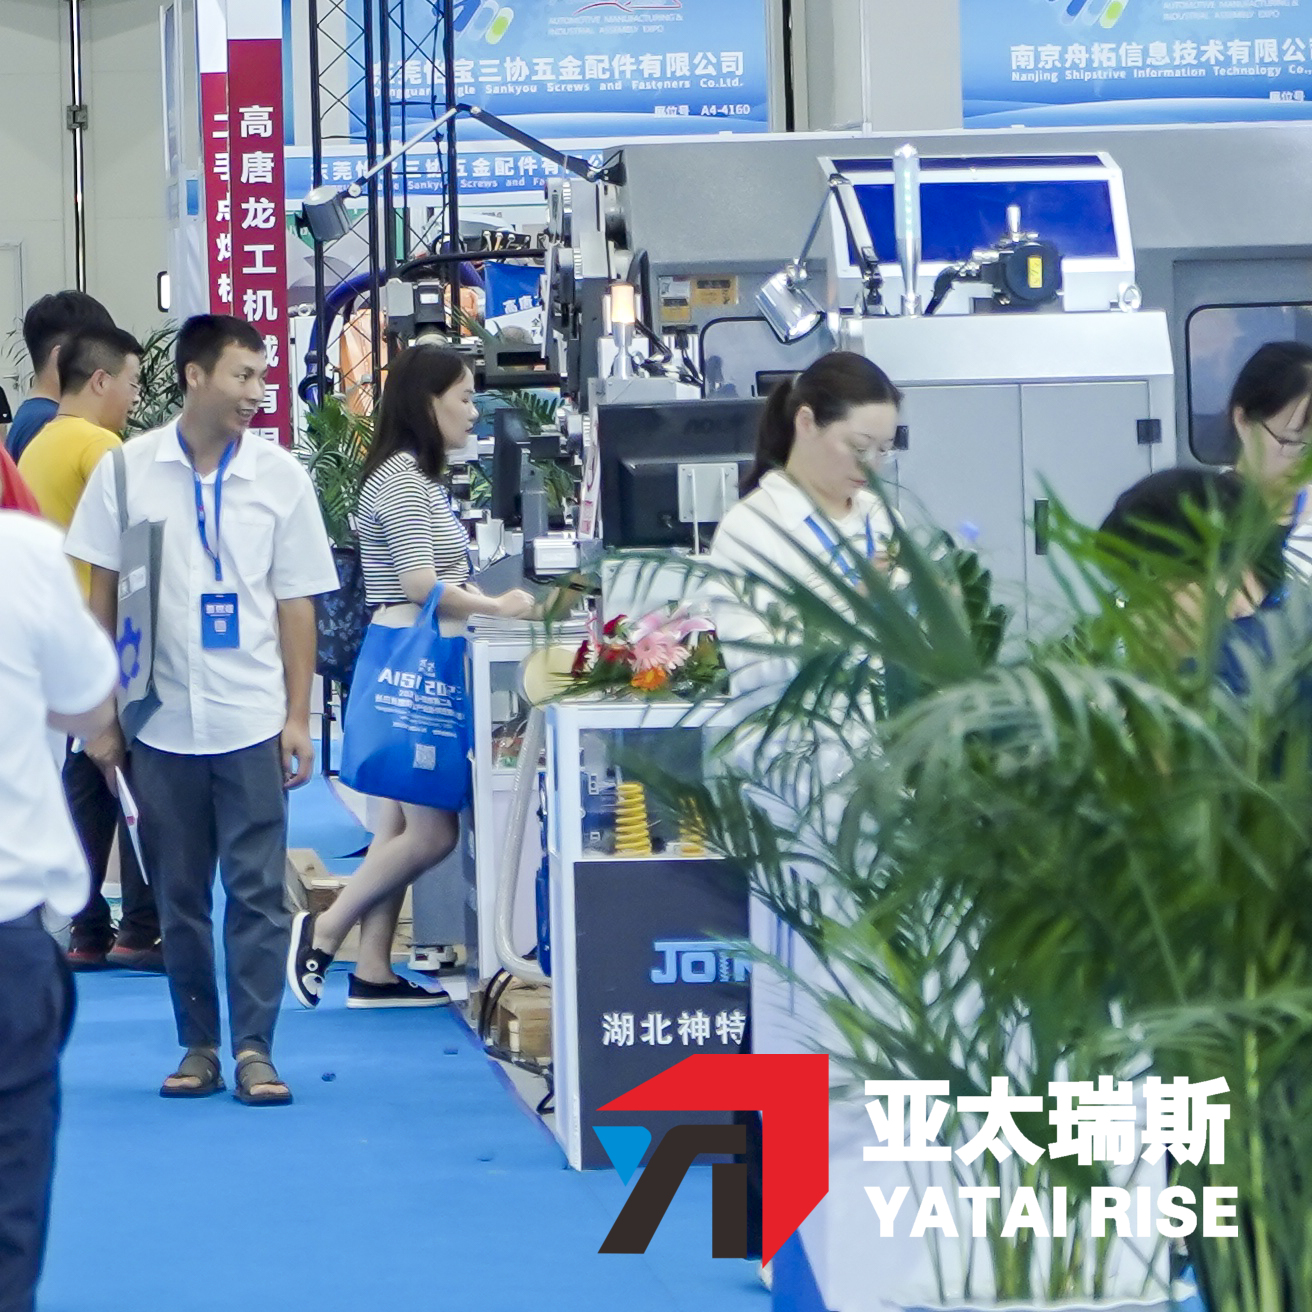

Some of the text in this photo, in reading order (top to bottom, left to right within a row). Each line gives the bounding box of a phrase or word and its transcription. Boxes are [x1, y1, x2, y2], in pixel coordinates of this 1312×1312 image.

[1010, 37, 1312, 69] 南京舟拓信息技术有限公
[1011, 71, 1058, 83] Nanjing
[1133, 67, 1206, 79] Information
[1212, 64, 1282, 77] Technology
[484, 81, 537, 95] Sankyou
[546, 80, 591, 92] Screws
[599, 79, 623, 91] and
[632, 77, 690, 90] Fasteners
[700, 104, 751, 117] A4-4160
[460, 178, 498, 189] Screws
[505, 176, 525, 187] and
[602, 1009, 747, 1047] 湖北神特
